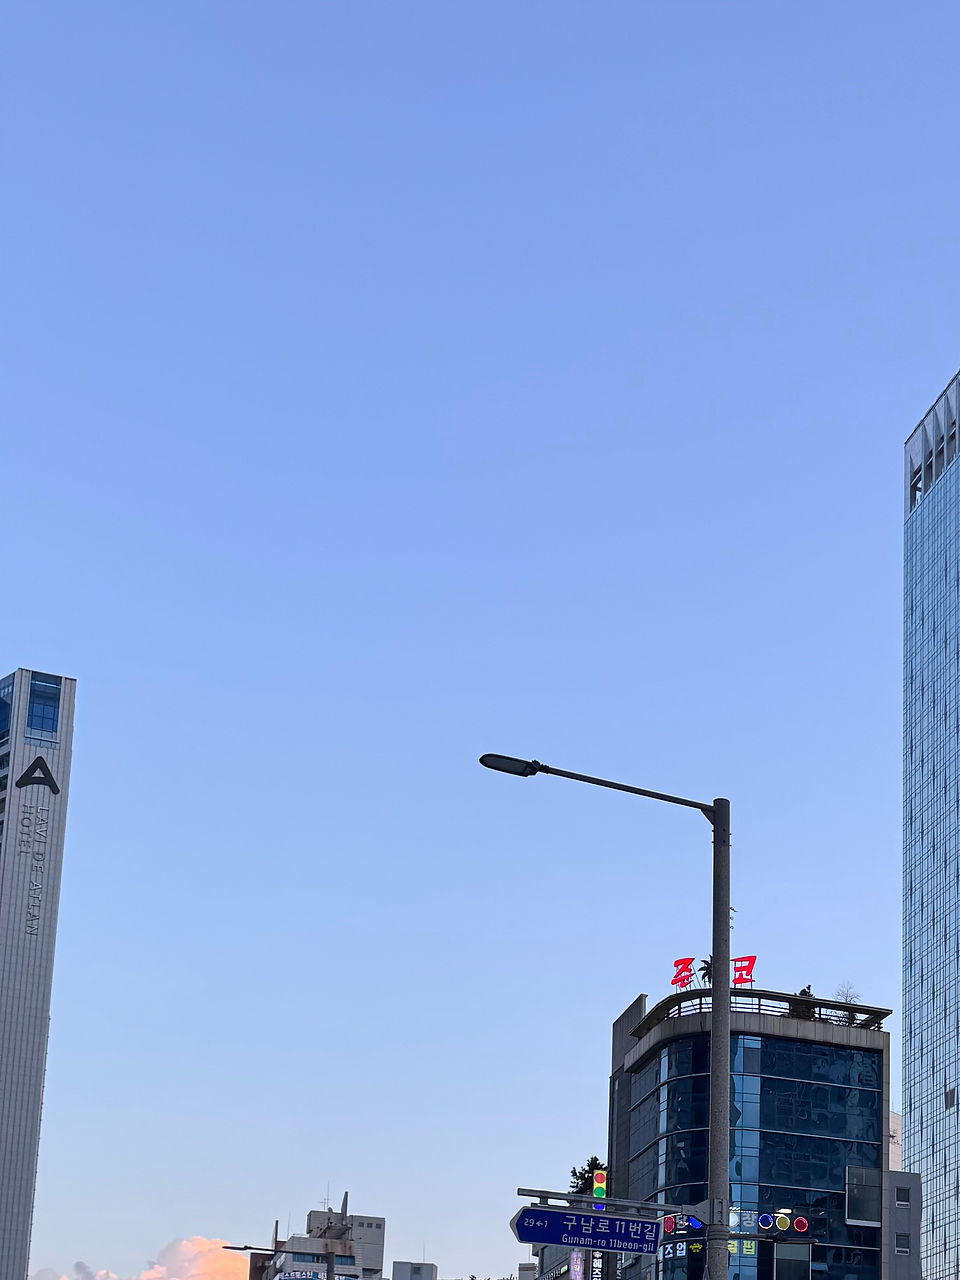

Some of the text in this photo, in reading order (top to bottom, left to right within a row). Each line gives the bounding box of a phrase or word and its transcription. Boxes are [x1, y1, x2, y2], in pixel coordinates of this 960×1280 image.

[18, 804, 34, 856] HOTEL
[562, 1234, 654, 1253] Gunam-ro 11beon-gil
